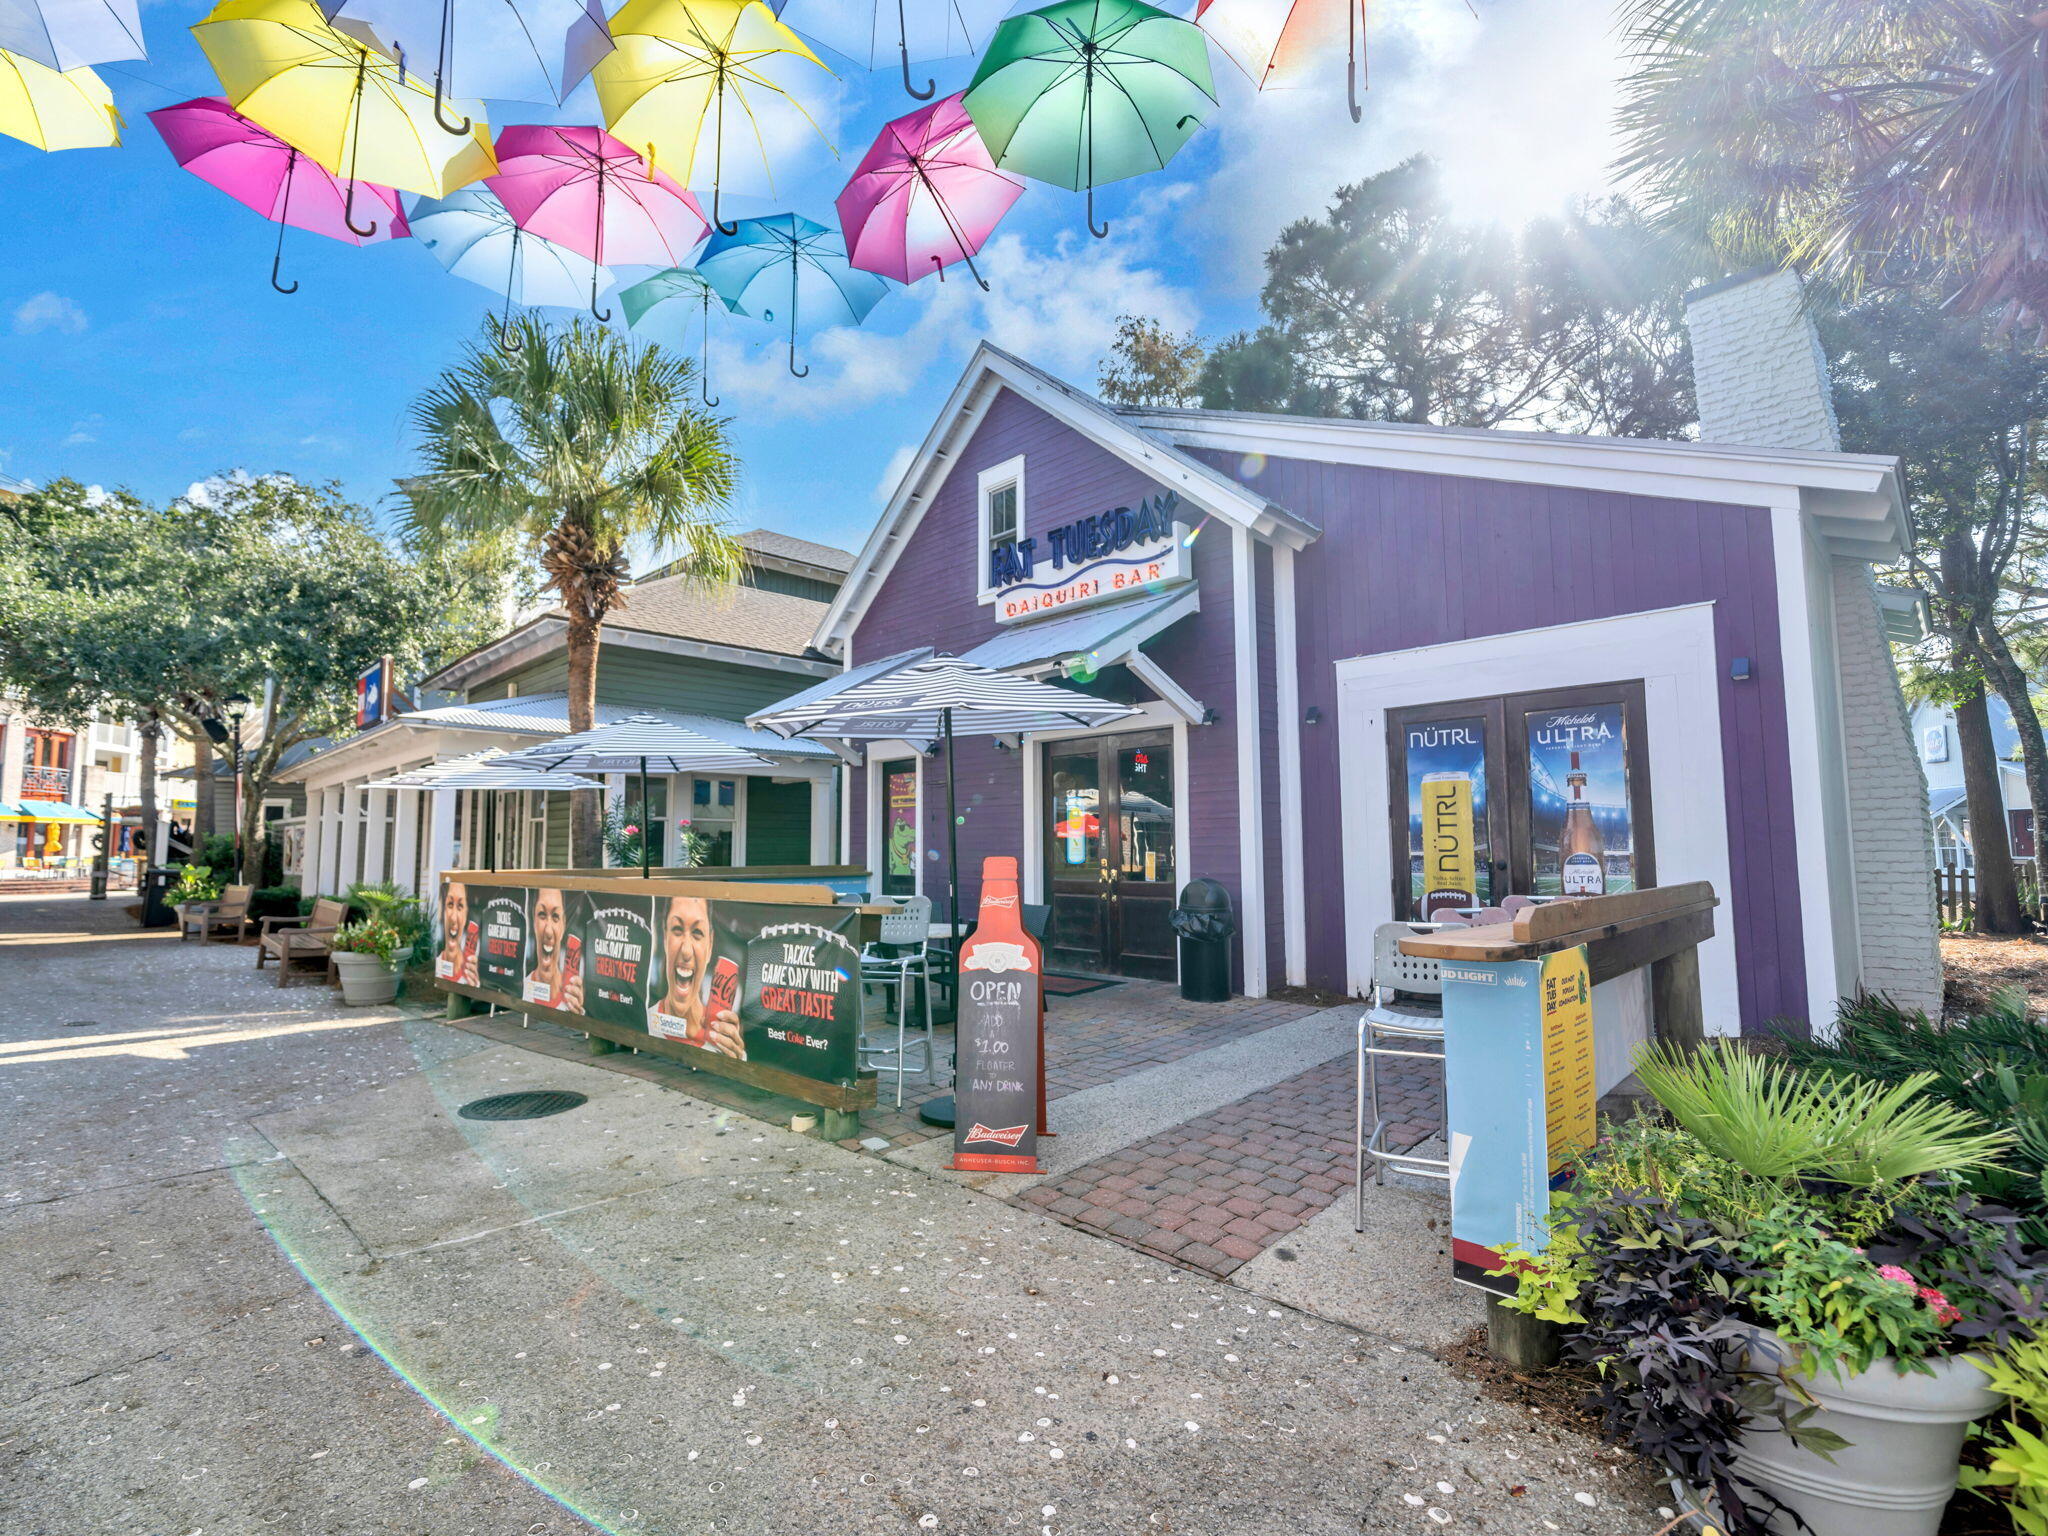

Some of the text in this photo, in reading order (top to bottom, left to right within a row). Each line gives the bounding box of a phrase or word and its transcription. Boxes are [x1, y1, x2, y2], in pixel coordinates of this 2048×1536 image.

[992, 490, 1179, 588] FAT TUESDAY
[1005, 563, 1161, 616] DAIQUIRI BAR
[1545, 712, 1598, 728] Michelob
[1536, 721, 1613, 744] ULTRA
[1565, 875, 1602, 884] ULTRA
[606, 923, 629, 942] TACKLE
[624, 943, 642, 962] WITH
[782, 943, 816, 967] TACKLE
[596, 956, 616, 978] GREAT
[1440, 970, 1495, 983] UD LIGHT
[761, 963, 839, 993] GAME DAY WITH
[1546, 977, 1556, 990] FAT
[598, 988, 609, 999] Best
[620, 993, 633, 1006] Ever?
[970, 981, 1021, 1002] OPEN
[761, 987, 797, 1013] GREAT
[798, 991, 835, 1020] TASTE
[1546, 1001, 1557, 1012] DAY
[768, 1028, 828, 1050] Best Coke Ever?
[974, 1037, 1009, 1054] $1.00
[976, 1060, 1016, 1071] FLOATER
[972, 1079, 1025, 1093] ANY DRINK
[968, 1127, 1021, 1140] Budweiser
